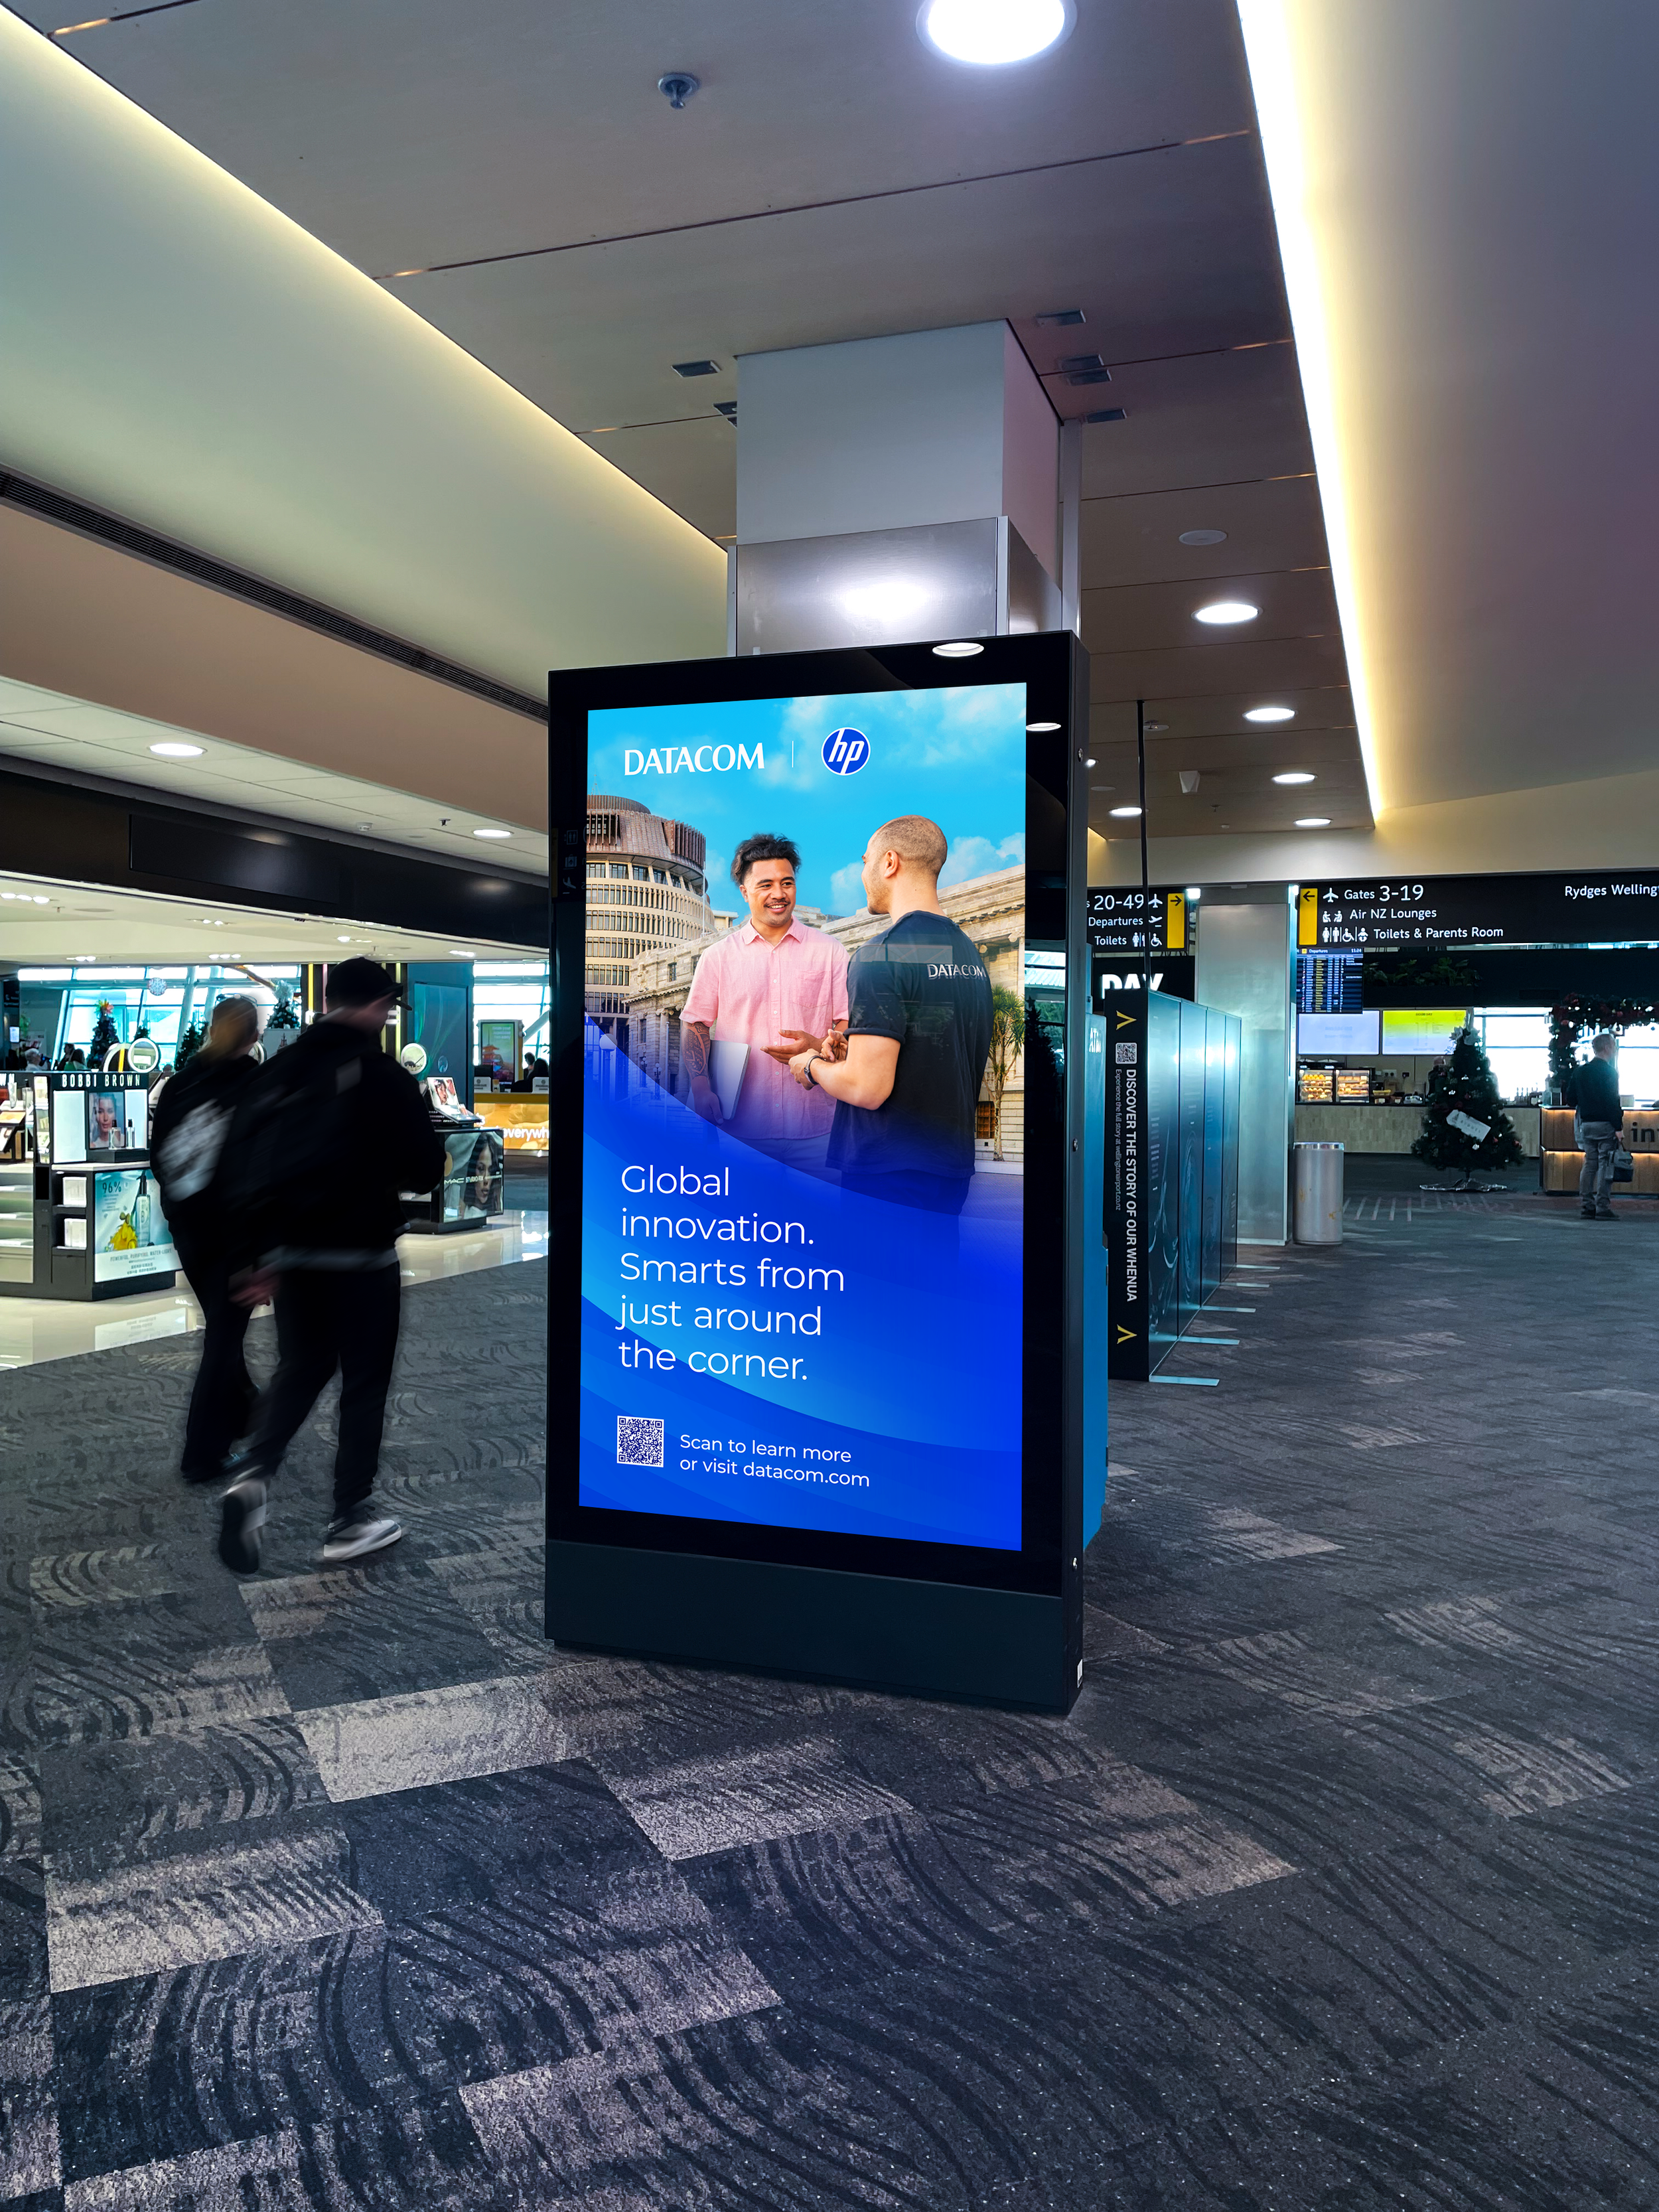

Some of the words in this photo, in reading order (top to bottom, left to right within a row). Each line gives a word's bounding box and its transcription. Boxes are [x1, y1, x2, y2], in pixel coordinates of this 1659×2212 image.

[624, 743, 764, 775] DATACOM
[827, 726, 865, 776] hp
[1094, 894, 1144, 910] 20-49
[1344, 889, 1375, 899] Gates
[1379, 885, 1424, 902] 3-19
[1565, 885, 1607, 900] Rydges
[1611, 884, 1659, 897] Welling
[1088, 917, 1143, 928] Departures
[1349, 909, 1367, 920] Air
[1370, 909, 1387, 919] NZ
[1391, 908, 1437, 921] Lounges
[1094, 935, 1127, 945] Toilets
[1374, 928, 1410, 939] Toilets
[1413, 928, 1422, 938] &
[1426, 927, 1468, 938] Parents
[1471, 926, 1504, 937] Room
[926, 964, 987, 978] DATACOM
[62, 1074, 97, 1088] BOBBI
[105, 1074, 140, 1087] BROWN
[1125, 1069, 1137, 1129] DISCOVER
[1125, 1132, 1137, 1156] THE
[1631, 1121, 1659, 1142] in
[102, 1181, 122, 1194] 96%
[621, 1164, 730, 1196] Global
[1126, 1158, 1137, 1199] STORY
[1126, 1201, 1137, 1217] OF
[621, 1207, 814, 1244] innovation.
[1126, 1219, 1137, 1245] OUR
[620, 1252, 746, 1286] Smarts
[757, 1258, 844, 1291] from
[1126, 1248, 1137, 1301] WHENUA
[614, 1294, 682, 1331] just
[694, 1305, 822, 1336] around
[618, 1339, 676, 1370] the
[687, 1351, 808, 1380] corner.
[680, 1434, 723, 1451] Scan
[727, 1439, 746, 1454] to
[752, 1439, 796, 1458] learn
[803, 1447, 851, 1463] more
[680, 1459, 698, 1471] or
[702, 1457, 738, 1475] visit
[743, 1459, 870, 1487] datacom.com
